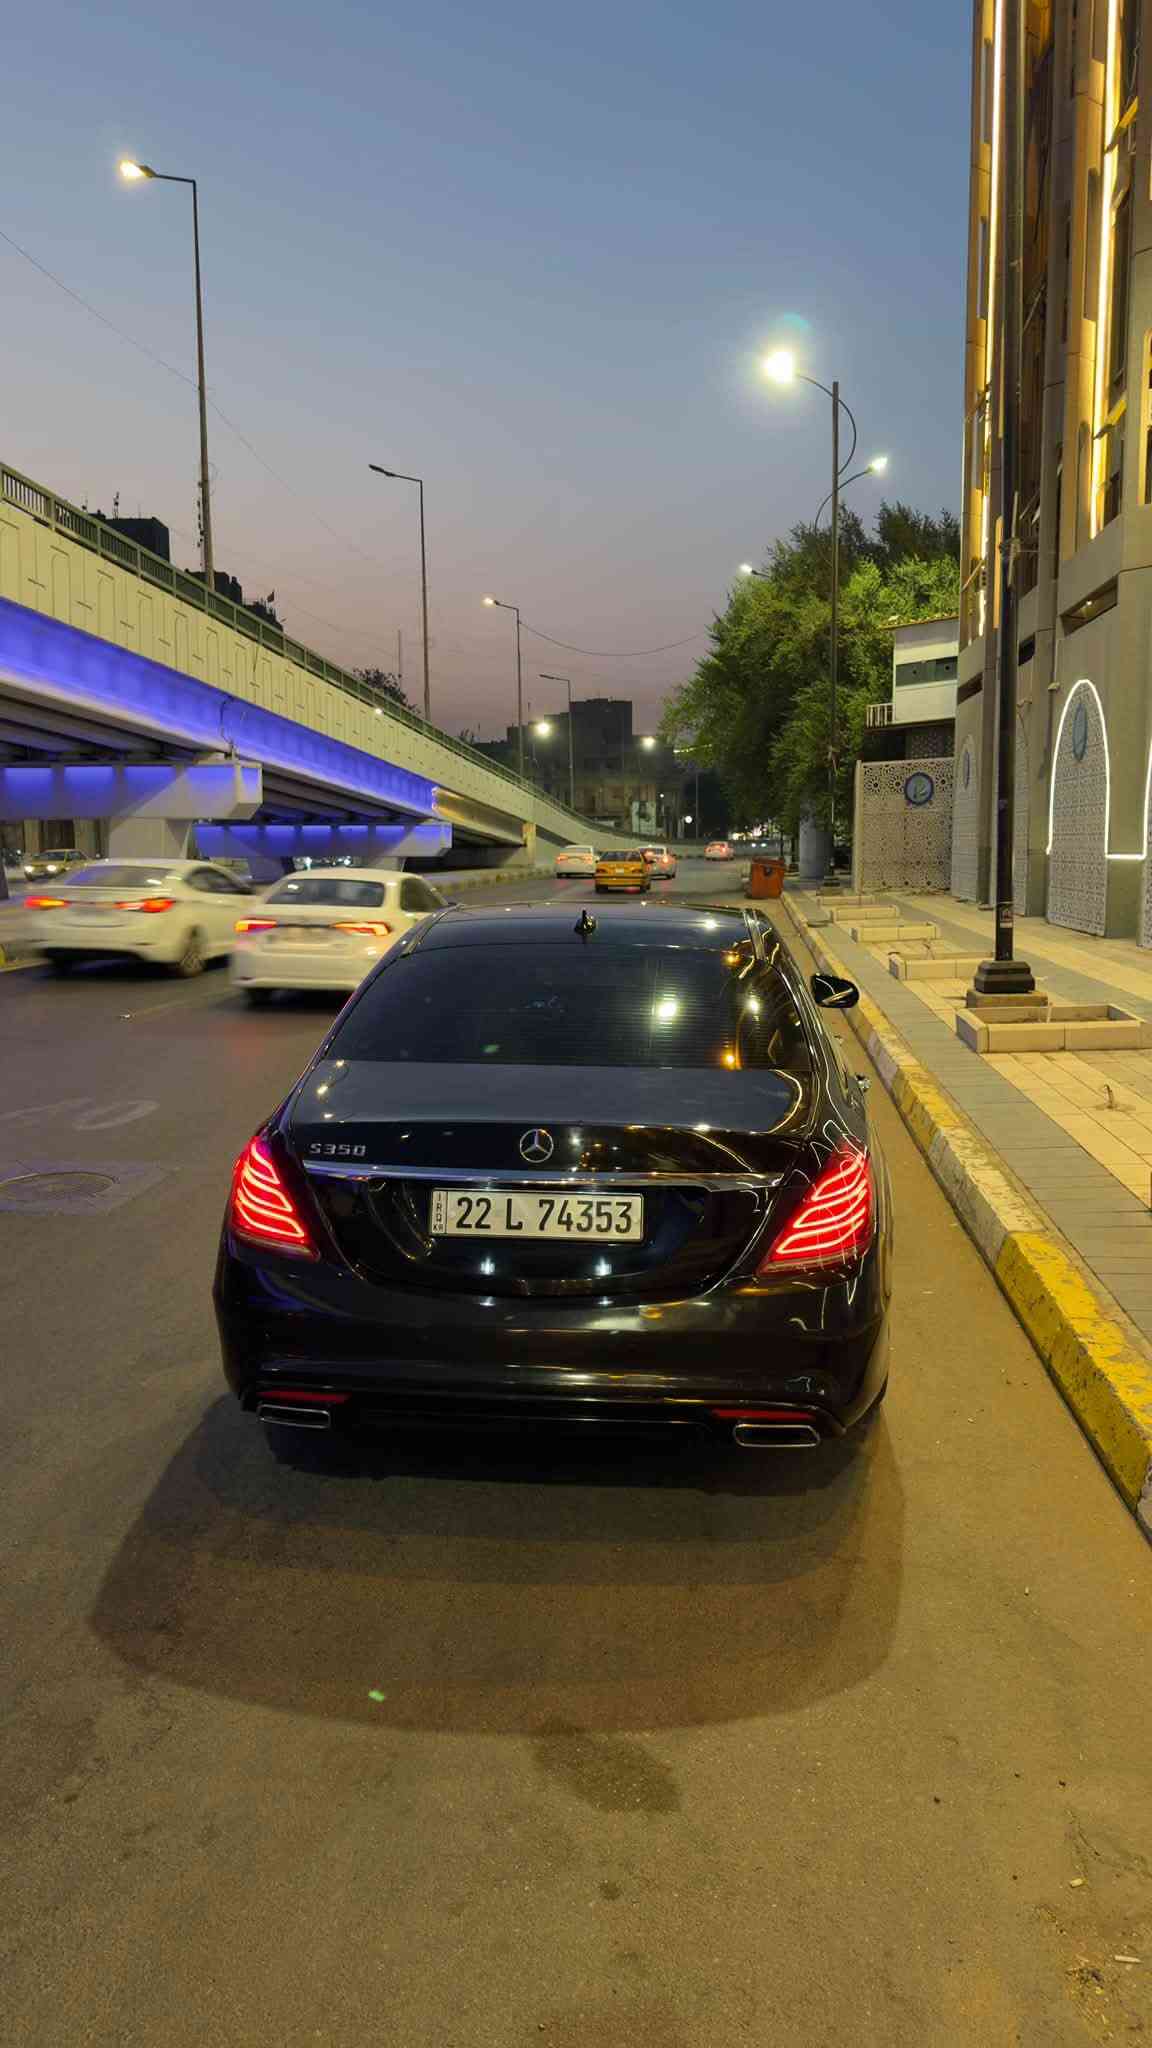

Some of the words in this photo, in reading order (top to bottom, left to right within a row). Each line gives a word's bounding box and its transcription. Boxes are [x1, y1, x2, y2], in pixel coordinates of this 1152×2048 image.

[309, 1143, 367, 1157] S350
[456, 1197, 491, 1229] 22
[506, 1198, 523, 1230] L
[539, 1199, 632, 1233] 74353
